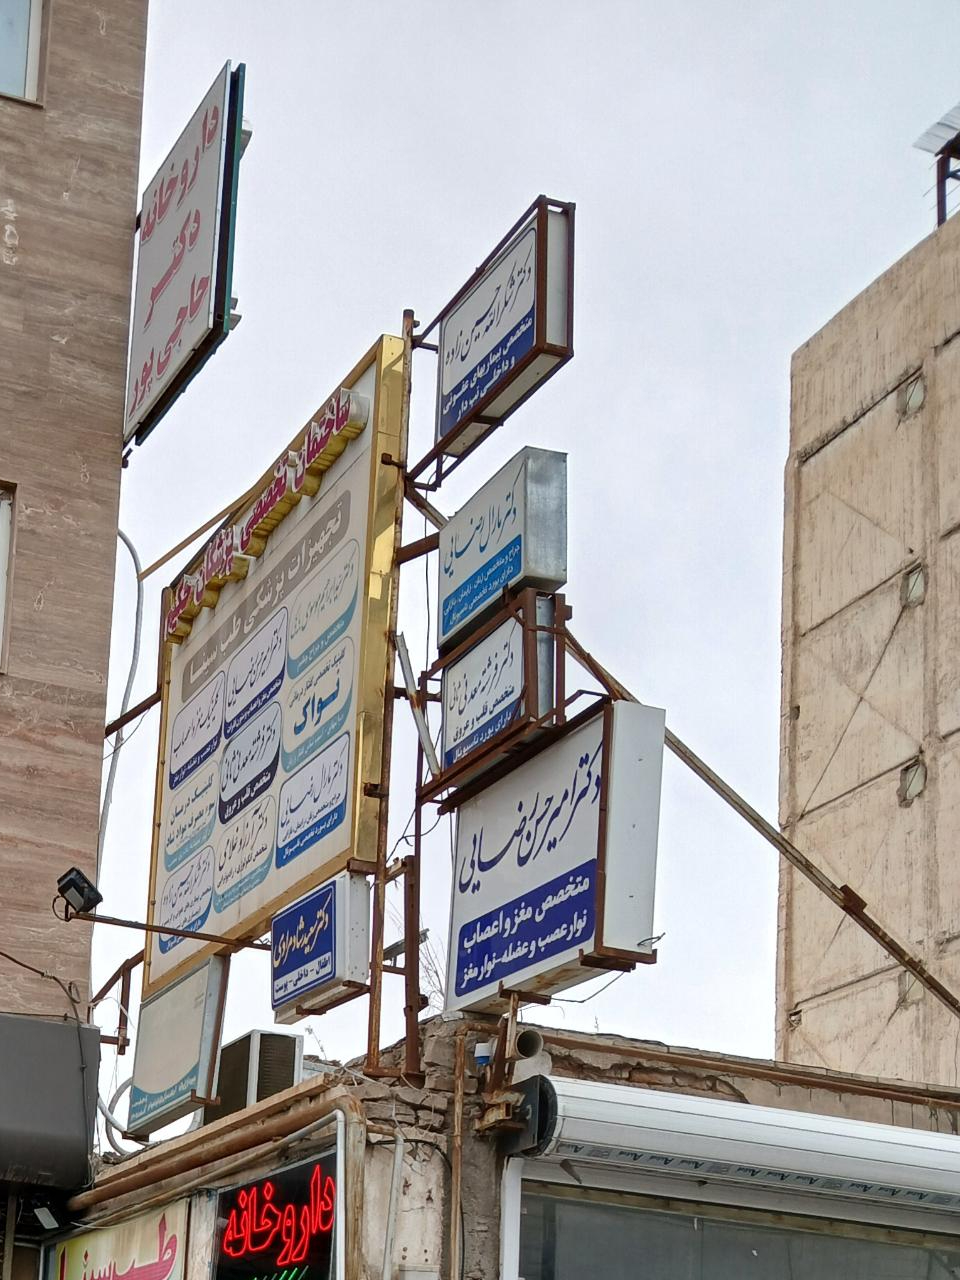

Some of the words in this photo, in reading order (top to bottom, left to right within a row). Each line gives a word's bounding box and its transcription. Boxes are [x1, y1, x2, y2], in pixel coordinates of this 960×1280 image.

[140, 105, 219, 245] داروخانه
[143, 208, 201, 329] دکتر
[156, 274, 210, 376] حاجی
[503, 317, 533, 357] متخصص
[243, 572, 284, 632] پزشکی
[559, 739, 603, 842] دکتر
[463, 911, 503, 950] اعصاب
[535, 875, 590, 923] متخصص
[222, 1163, 336, 1266] داروخانه
